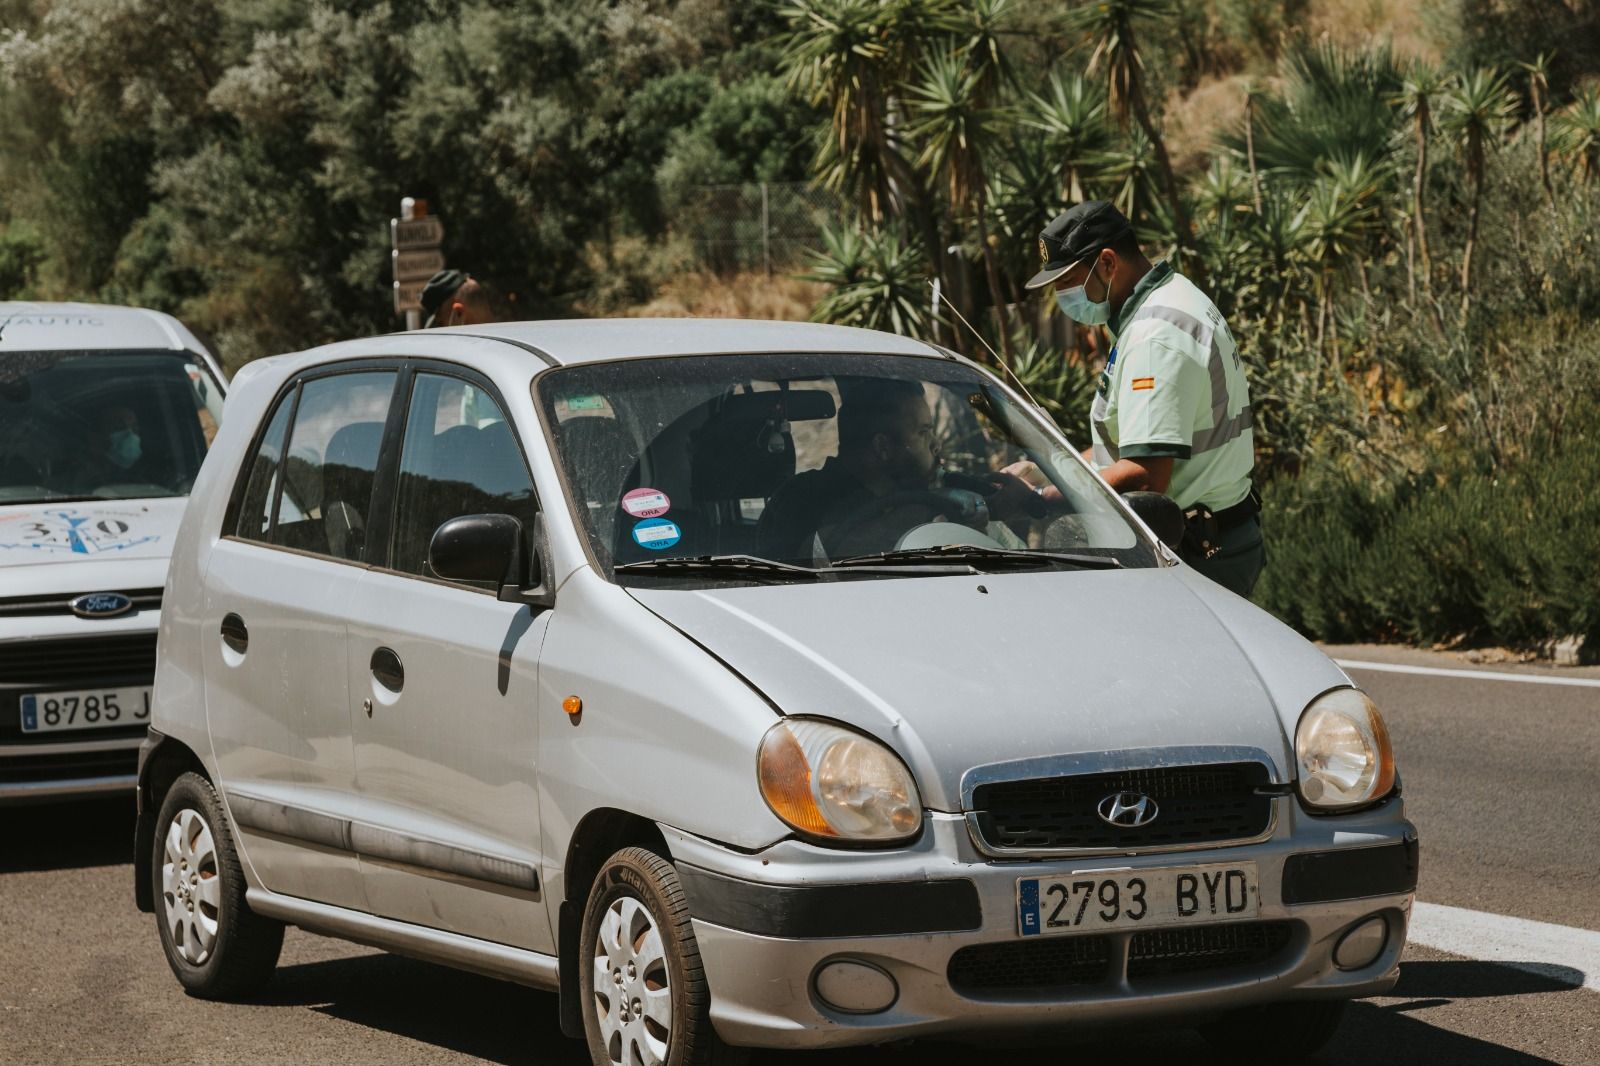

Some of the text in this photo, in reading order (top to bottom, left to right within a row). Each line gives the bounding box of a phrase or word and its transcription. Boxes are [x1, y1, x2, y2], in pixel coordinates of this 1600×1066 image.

[86, 597, 118, 611] Ford
[43, 691, 149, 726] 8785 J
[1046, 869, 1248, 928] 2793 BYD
[1025, 912, 1035, 926] E
